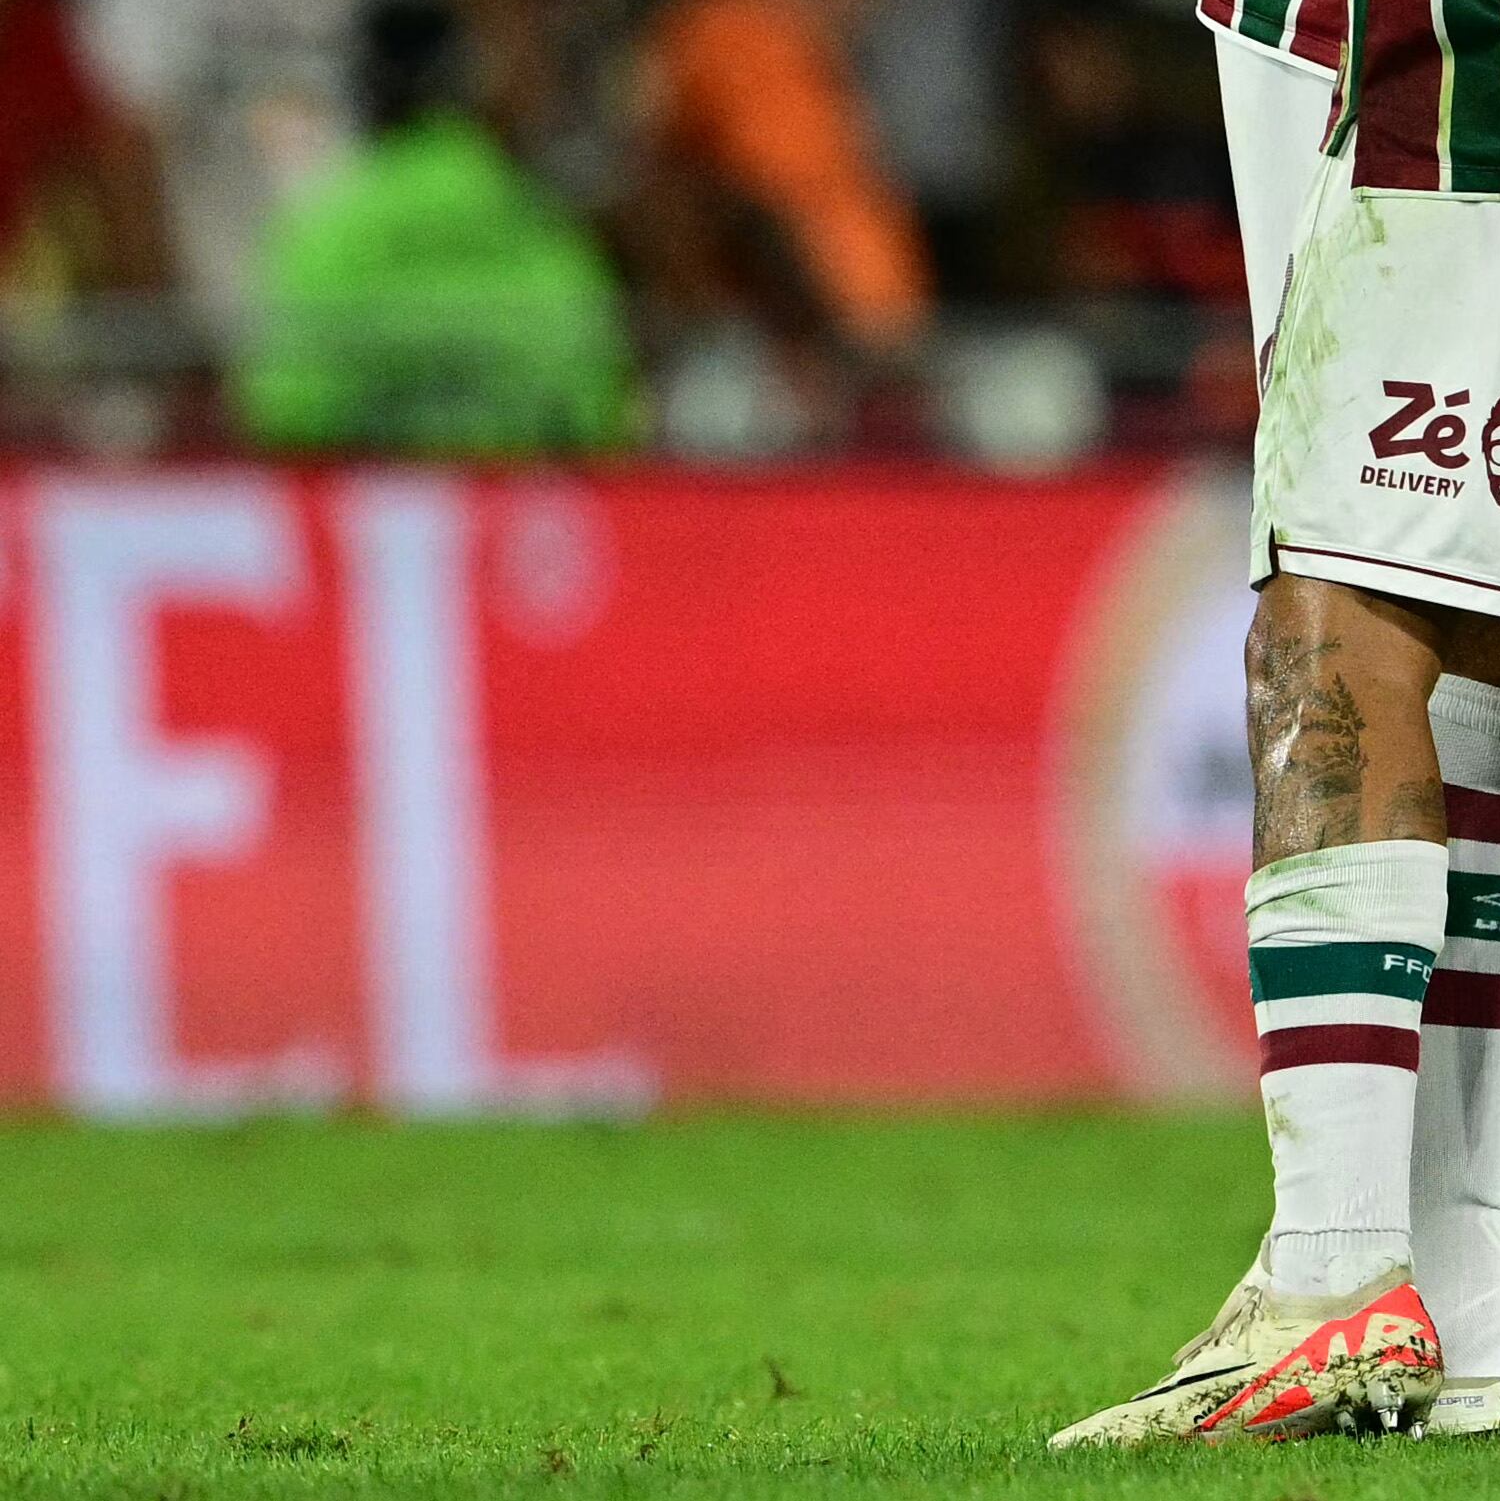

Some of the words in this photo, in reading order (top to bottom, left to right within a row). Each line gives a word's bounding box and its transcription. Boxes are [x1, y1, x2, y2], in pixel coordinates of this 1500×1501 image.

[1368, 380, 1471, 469] Zé
[1360, 465, 1465, 499] DELIVERY
[25, 465, 655, 1120] EL
